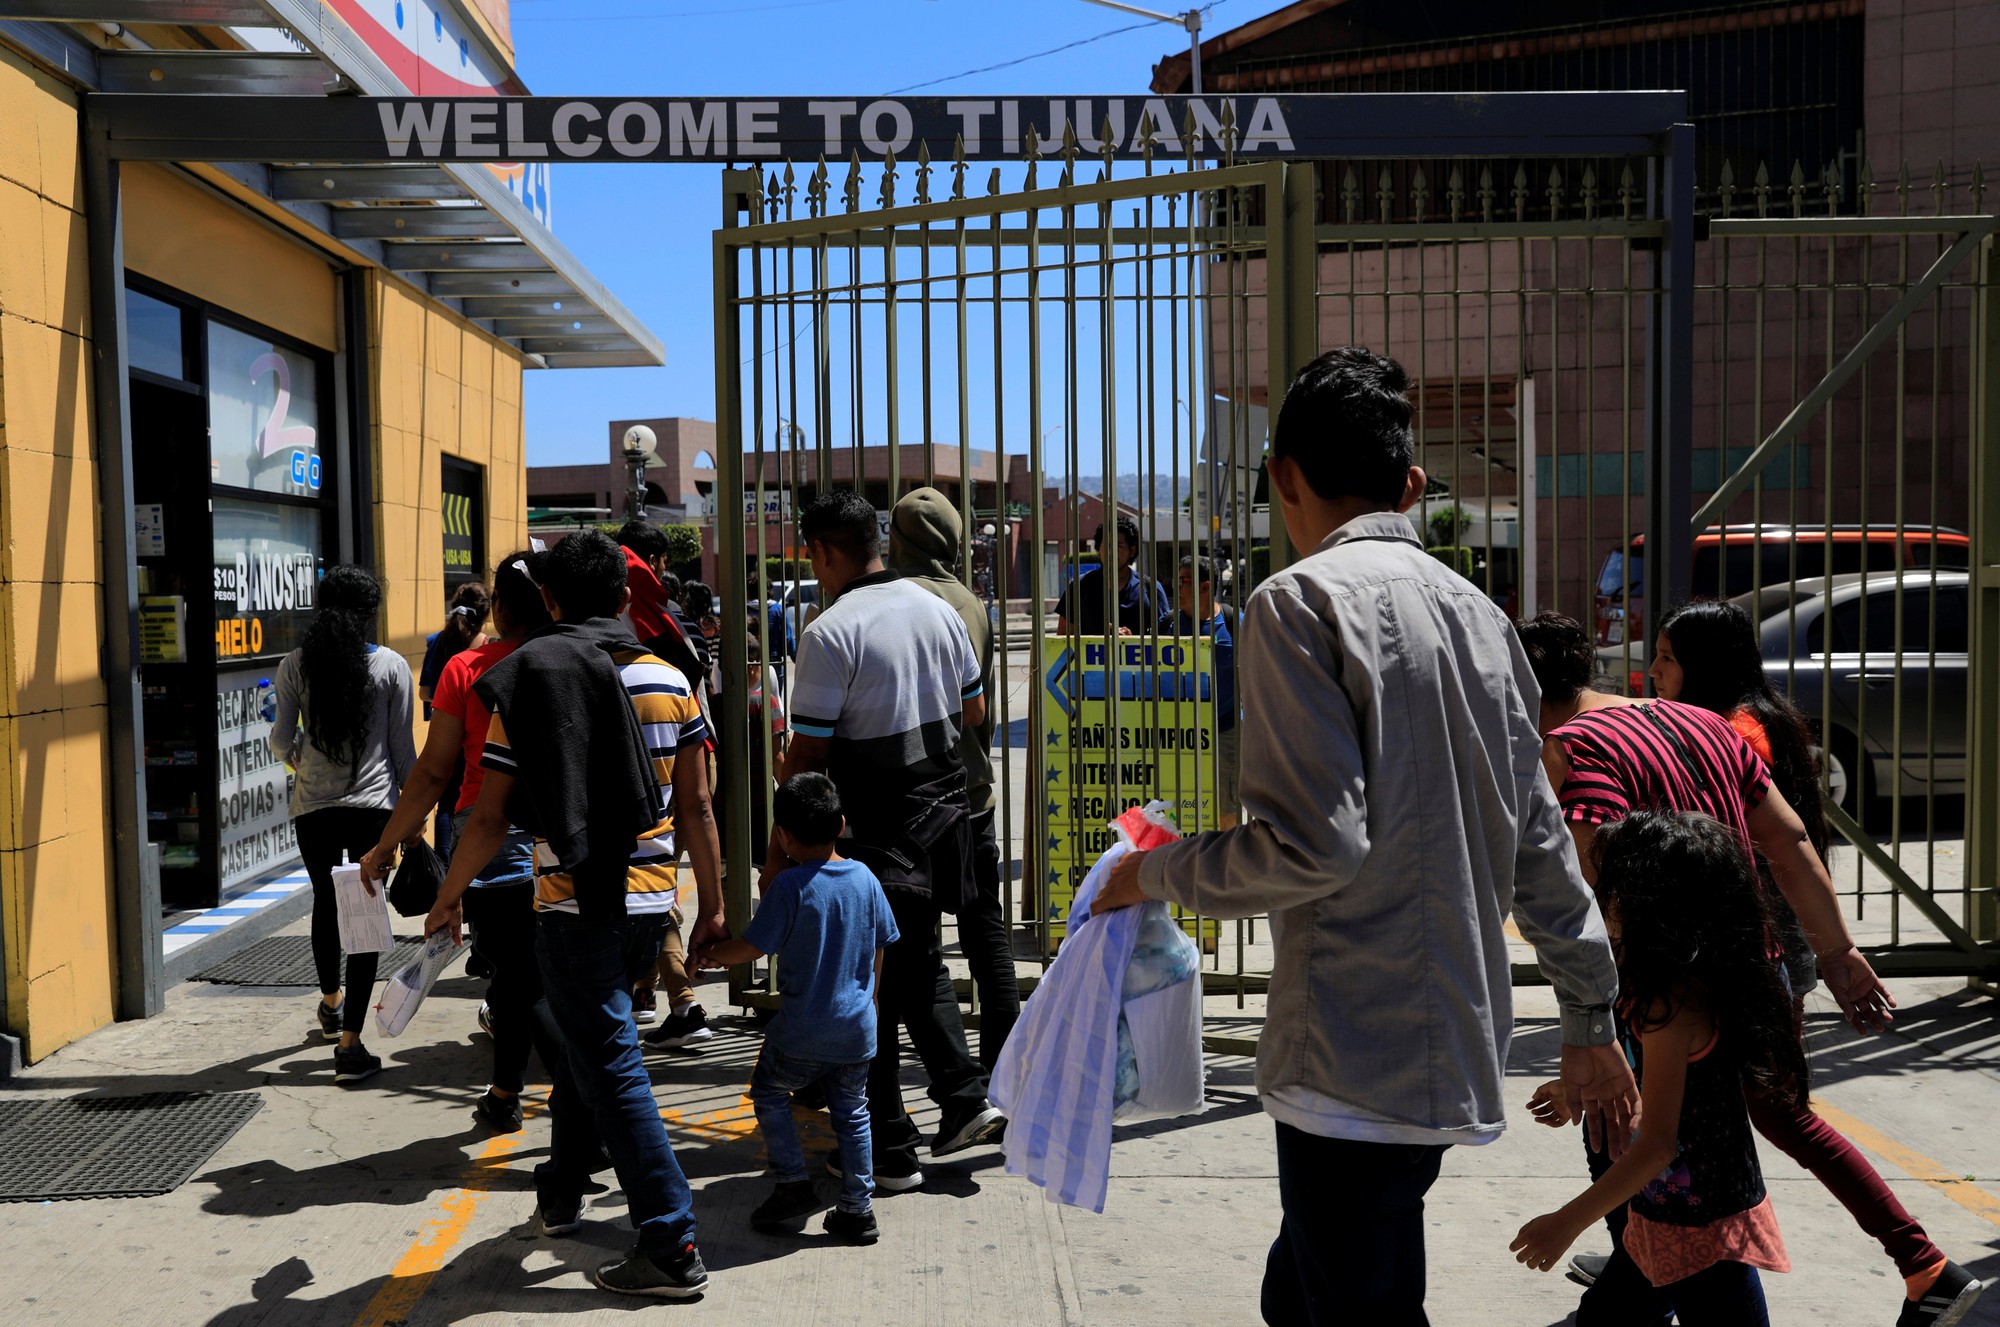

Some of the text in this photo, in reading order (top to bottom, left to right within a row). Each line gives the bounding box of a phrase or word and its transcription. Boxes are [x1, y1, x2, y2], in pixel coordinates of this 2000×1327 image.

[377, 97, 1296, 157] WELCOME TO TIJUANA
[249, 352, 316, 459] 2
[291, 450, 322, 490] GO
[746, 502, 780, 513] STOR
[213, 567, 236, 590] $10
[214, 590, 236, 601] PESOS
[215, 618, 262, 656] HIELO
[217, 736, 280, 781] INTERN
[219, 781, 274, 829] COPIAS
[220, 829, 269, 878] CASETAS
